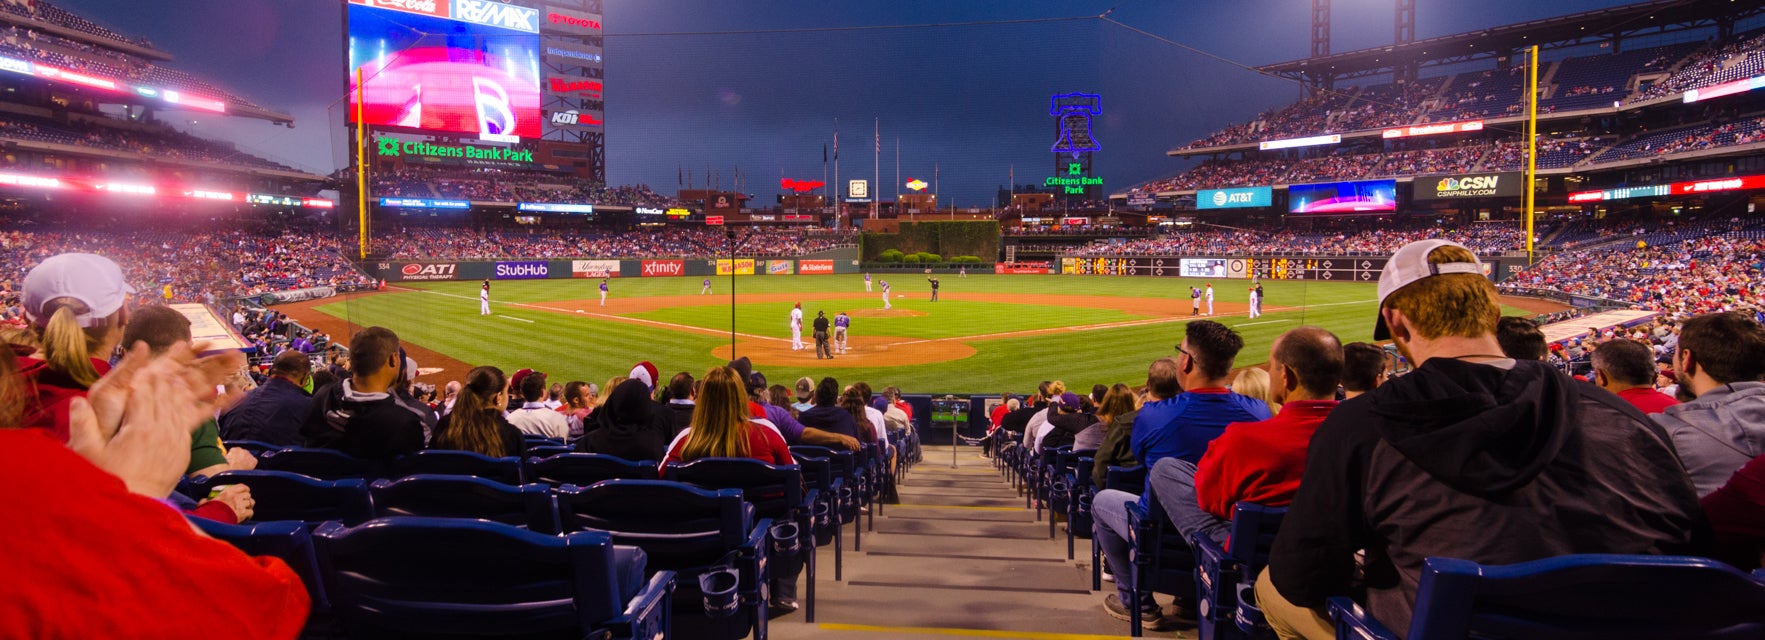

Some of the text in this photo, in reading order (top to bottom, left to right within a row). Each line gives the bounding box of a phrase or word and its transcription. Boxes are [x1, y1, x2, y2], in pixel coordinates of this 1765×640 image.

[456, 0, 533, 31] RE/MAX
[562, 16, 601, 30] TOYOTA
[403, 140, 533, 163] Citizens Bank Park
[1046, 177, 1104, 186] Citizens Bank
[1460, 176, 1498, 190] CSN
[1065, 186, 1084, 195] Park
[1437, 189, 1496, 197] CSNPHILLY.COM
[1228, 192, 1254, 204] AT&T
[420, 263, 456, 275] ATI
[497, 264, 548, 276] StubHub
[645, 261, 682, 275] xfinity
